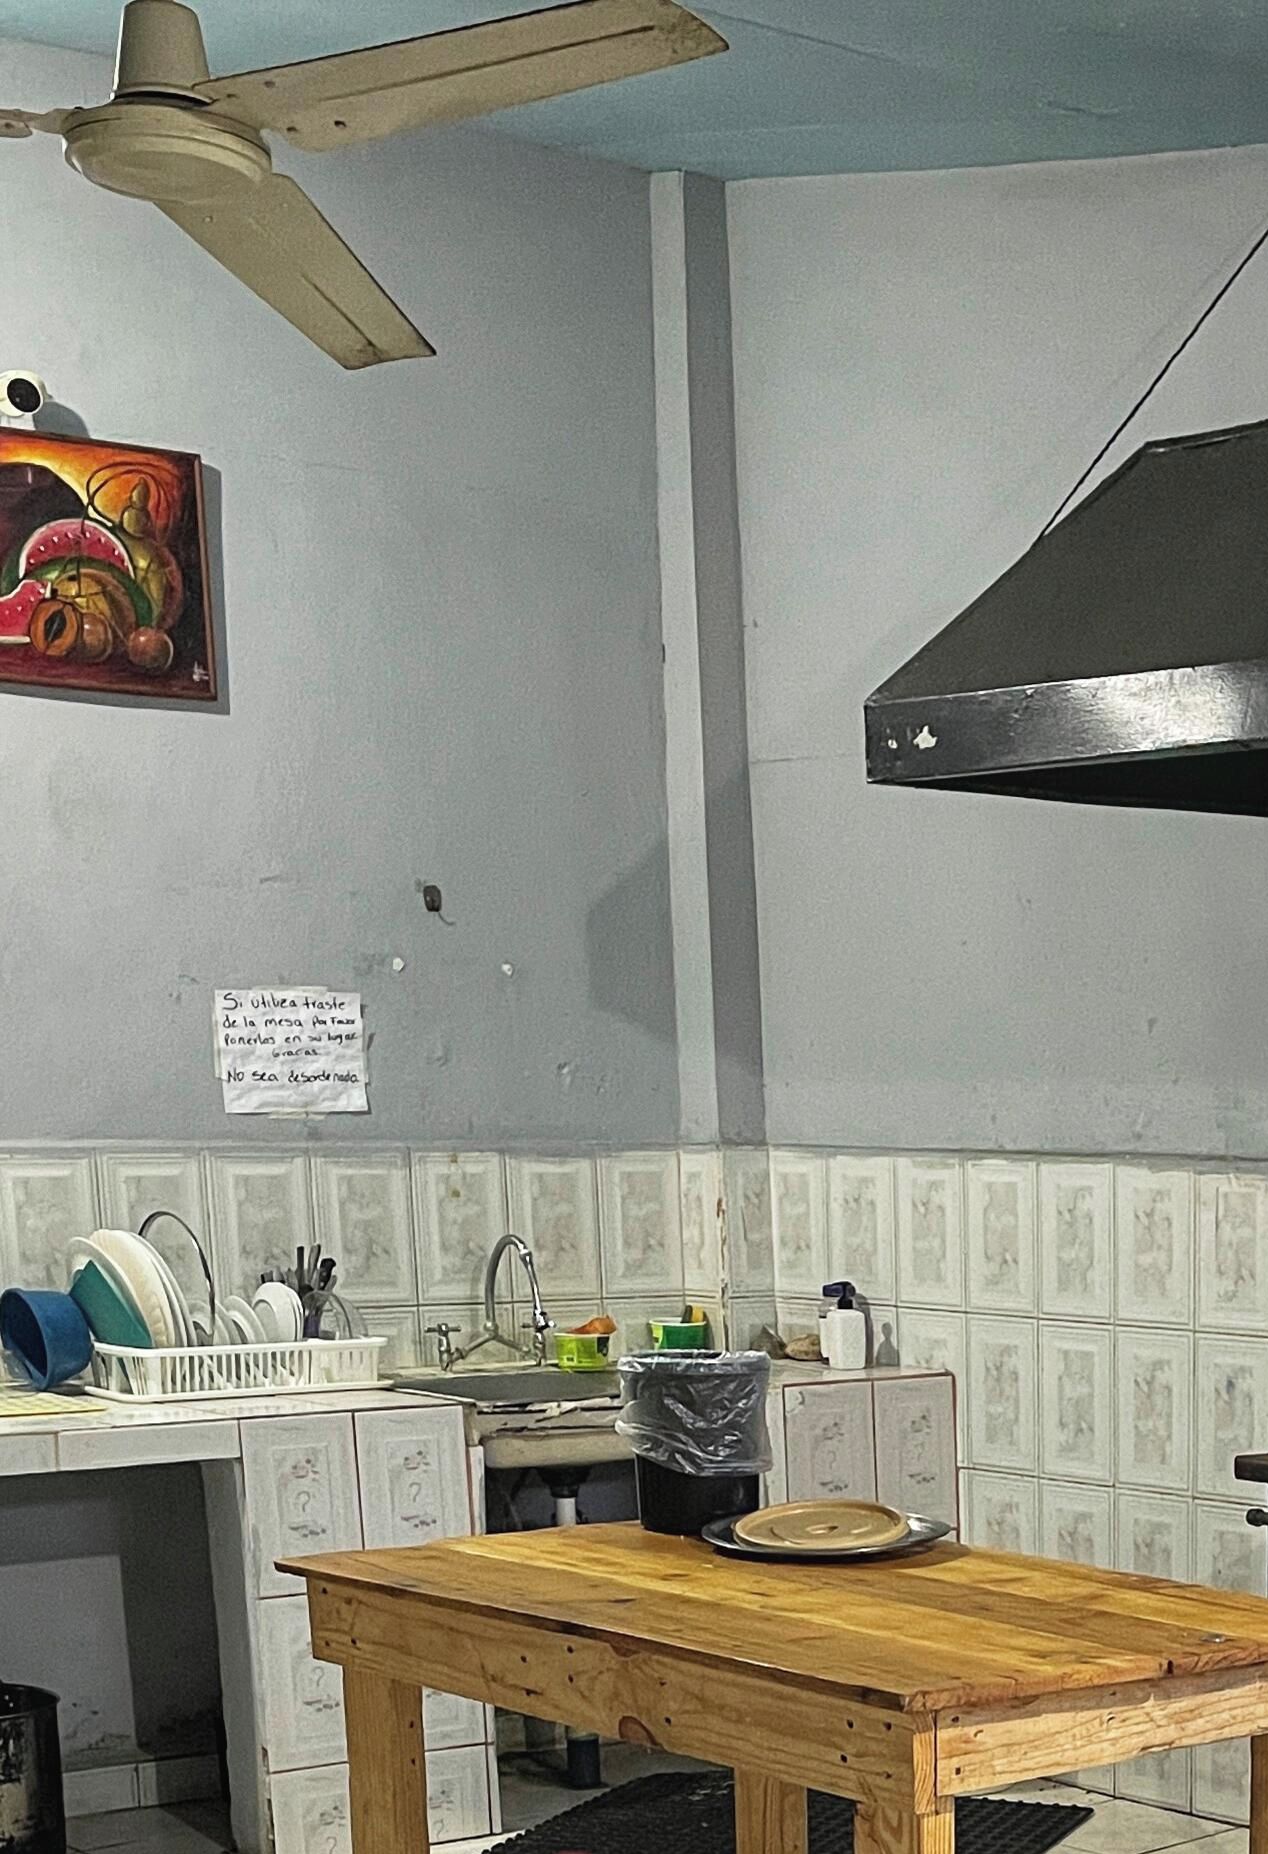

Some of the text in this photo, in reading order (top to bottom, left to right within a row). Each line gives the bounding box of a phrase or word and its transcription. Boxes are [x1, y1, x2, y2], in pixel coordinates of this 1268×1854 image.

[222, 992, 243, 1010] Si
[302, 996, 346, 1011] traste
[222, 1014, 238, 1029] de
[243, 1015, 256, 1028] la
[264, 1018, 303, 1028] mesa
[284, 1035, 302, 1043] en
[272, 1048, 320, 1058] Gracas
[227, 1067, 245, 1084] No
[252, 1070, 279, 1082] sea
